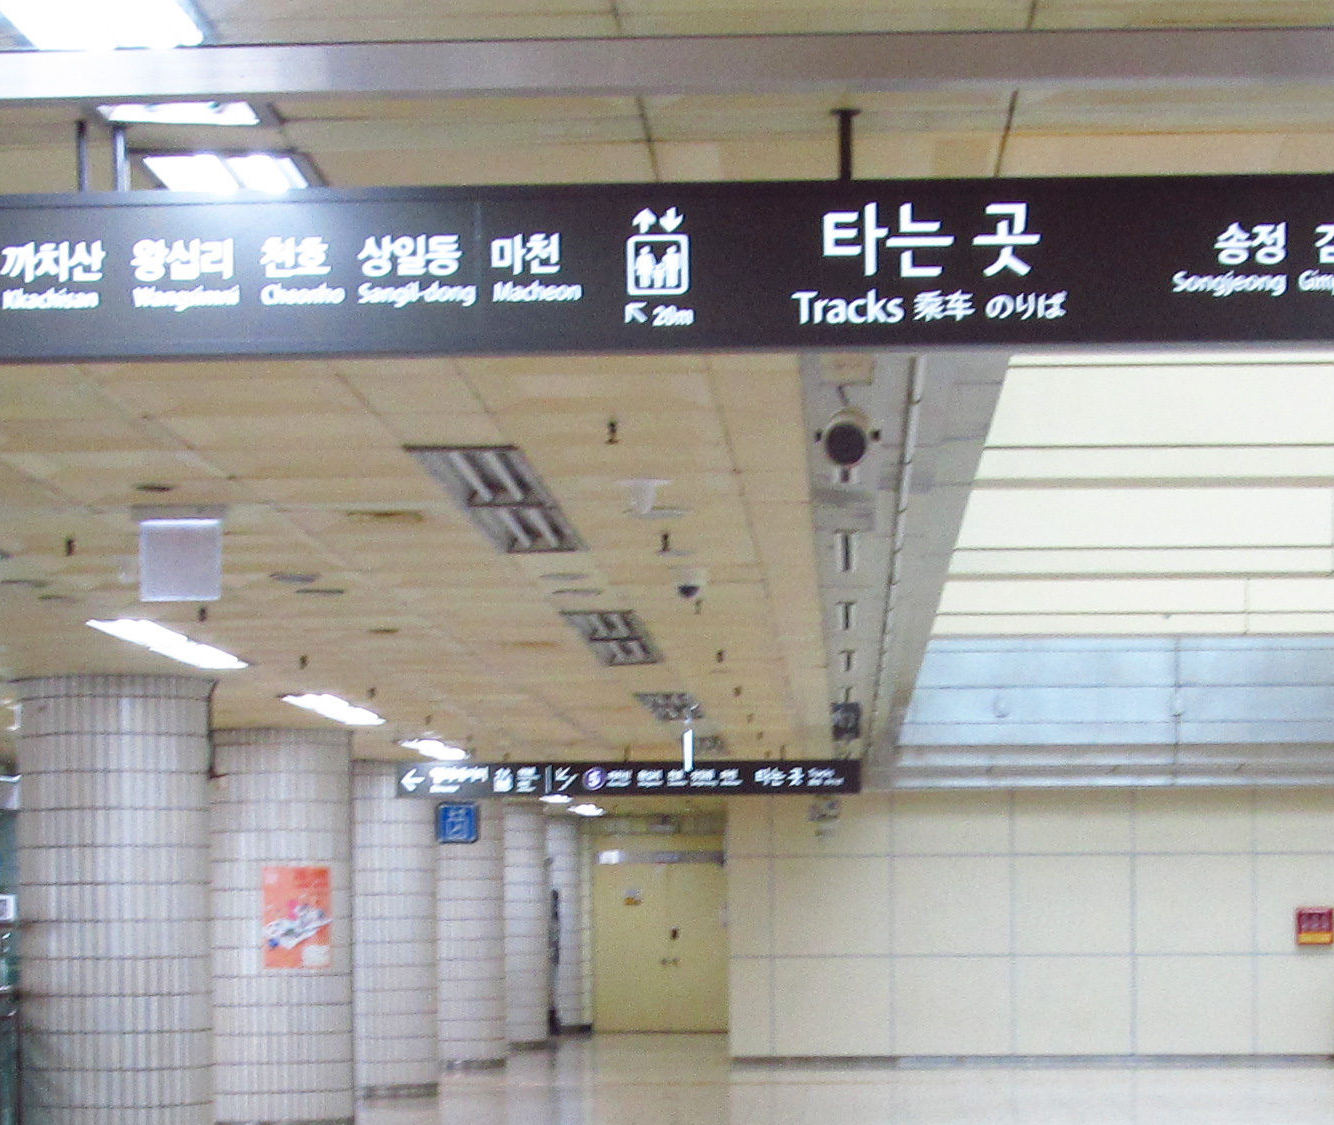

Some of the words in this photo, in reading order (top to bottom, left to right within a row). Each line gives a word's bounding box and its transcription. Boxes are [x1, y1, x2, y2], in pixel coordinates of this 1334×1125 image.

[0, 239, 106, 283] 까치산
[130, 237, 235, 282] 왕십리
[259, 235, 332, 279] 천호
[357, 233, 464, 277] 상일동
[490, 232, 562, 275] 마천
[821, 201, 956, 278] 타는
[971, 201, 1042, 278] 곳
[1213, 221, 1288, 265] 송정
[260, 281, 346, 307] Cheonho
[492, 280, 583, 303] Macheon
[1171, 269, 1288, 297] Songjeong
[790, 288, 906, 325] Tracks
[984, 289, 1069, 321] のりば
